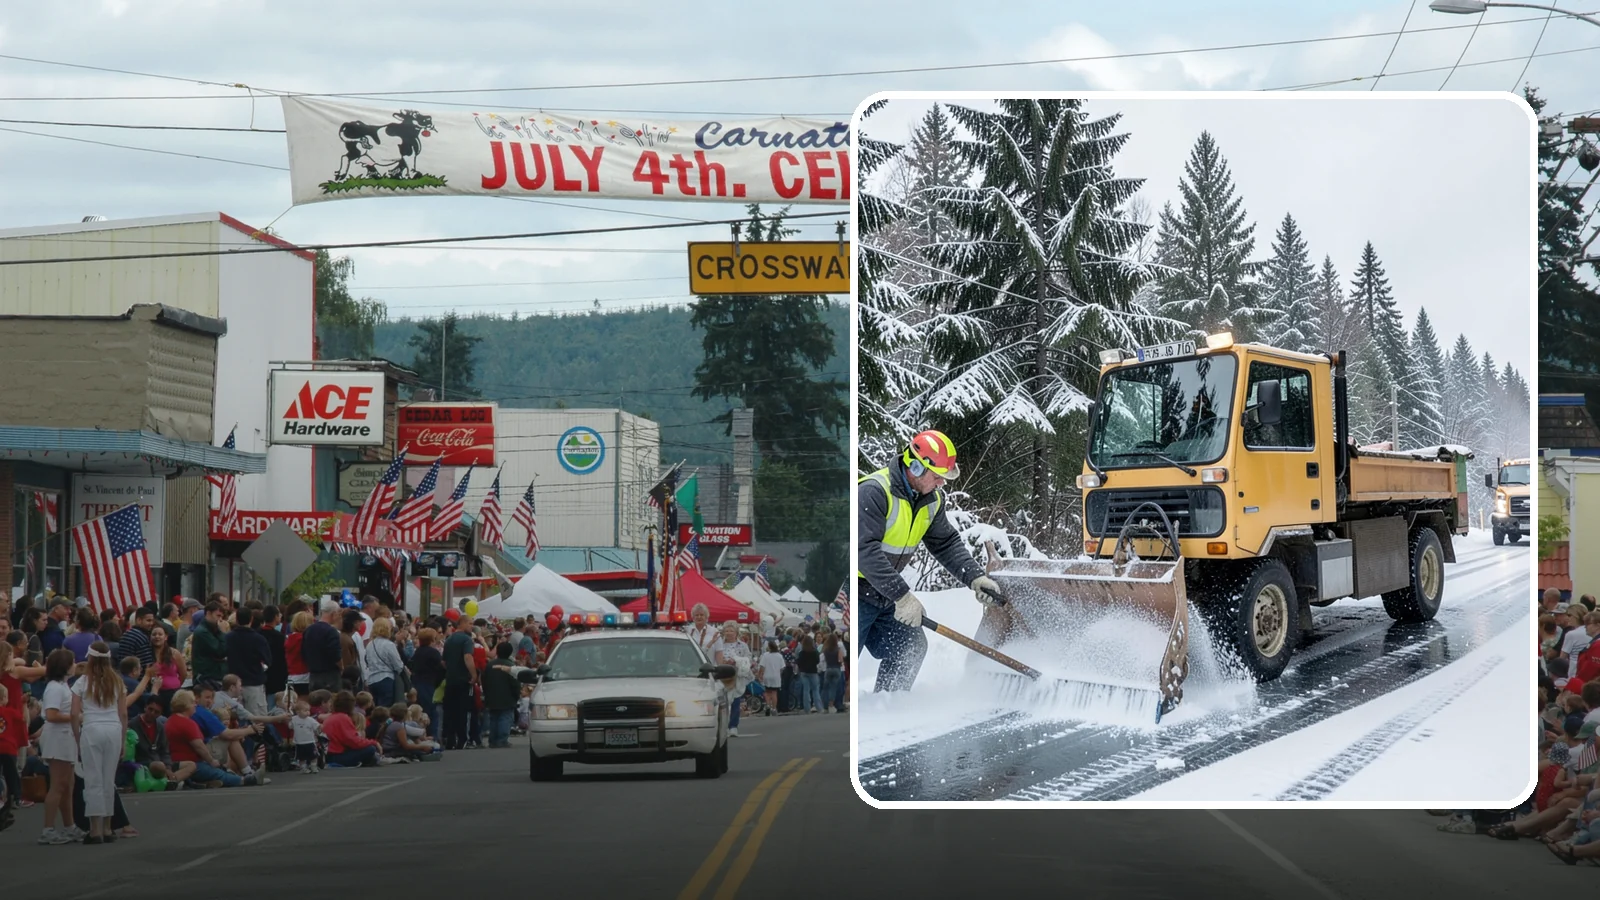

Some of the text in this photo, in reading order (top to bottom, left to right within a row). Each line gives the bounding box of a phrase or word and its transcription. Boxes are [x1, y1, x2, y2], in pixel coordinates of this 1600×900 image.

[481, 140, 605, 192] JULY
[632, 150, 747, 198] 4th.
[696, 253, 850, 280] CROSSWA
[282, 379, 374, 420] ACE
[405, 409, 485, 422] CEDAR LOG
[283, 421, 371, 436] Hardware
[416, 428, 477, 447] Coca-Cola
[83, 485, 155, 495] St. Vincent de Paul
[688, 526, 742, 535] CRNATION
[699, 535, 730, 543] GLASS
